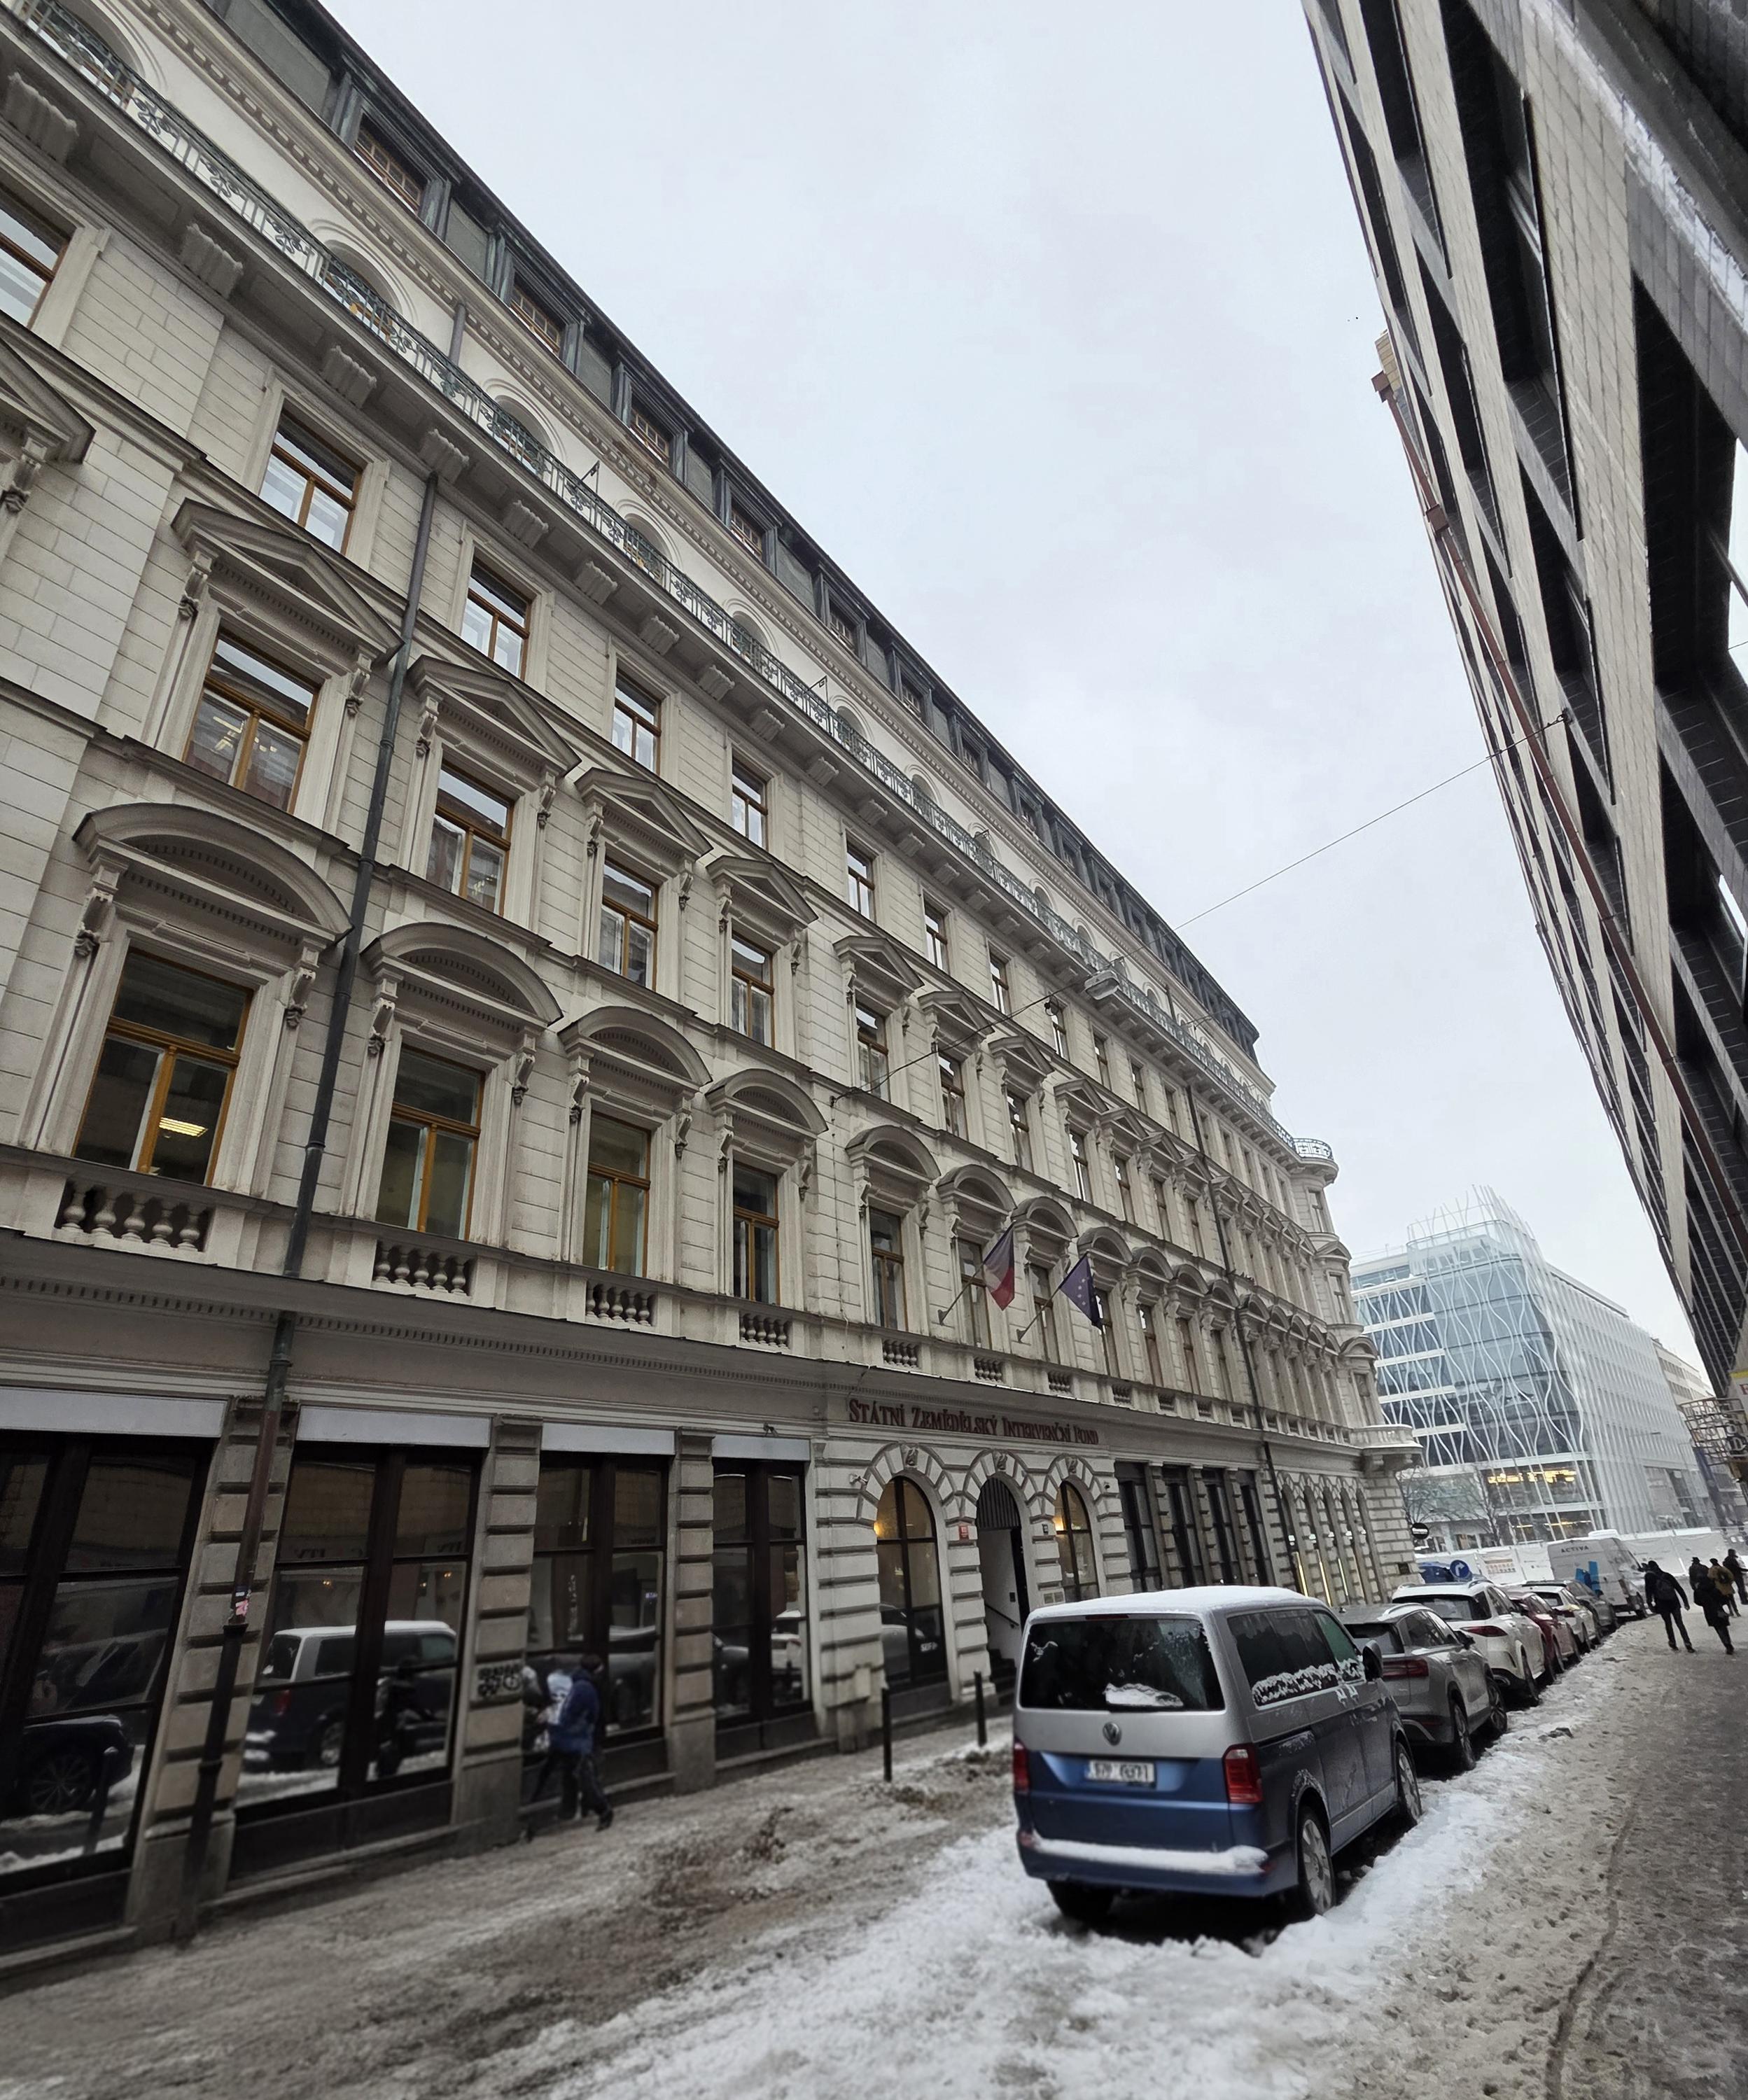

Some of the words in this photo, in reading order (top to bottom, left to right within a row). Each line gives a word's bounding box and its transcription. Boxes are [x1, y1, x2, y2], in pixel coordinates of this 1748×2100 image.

[849, 1399, 906, 1427] STÁTNÍ
[911, 1407, 998, 1436] ZEMĚDĚLSKÝ
[1002, 1417, 1072, 1443] INTERVENČNÍ
[1073, 1424, 1100, 1446] FOND
[1561, 1545, 1590, 1553] ACTIVA
